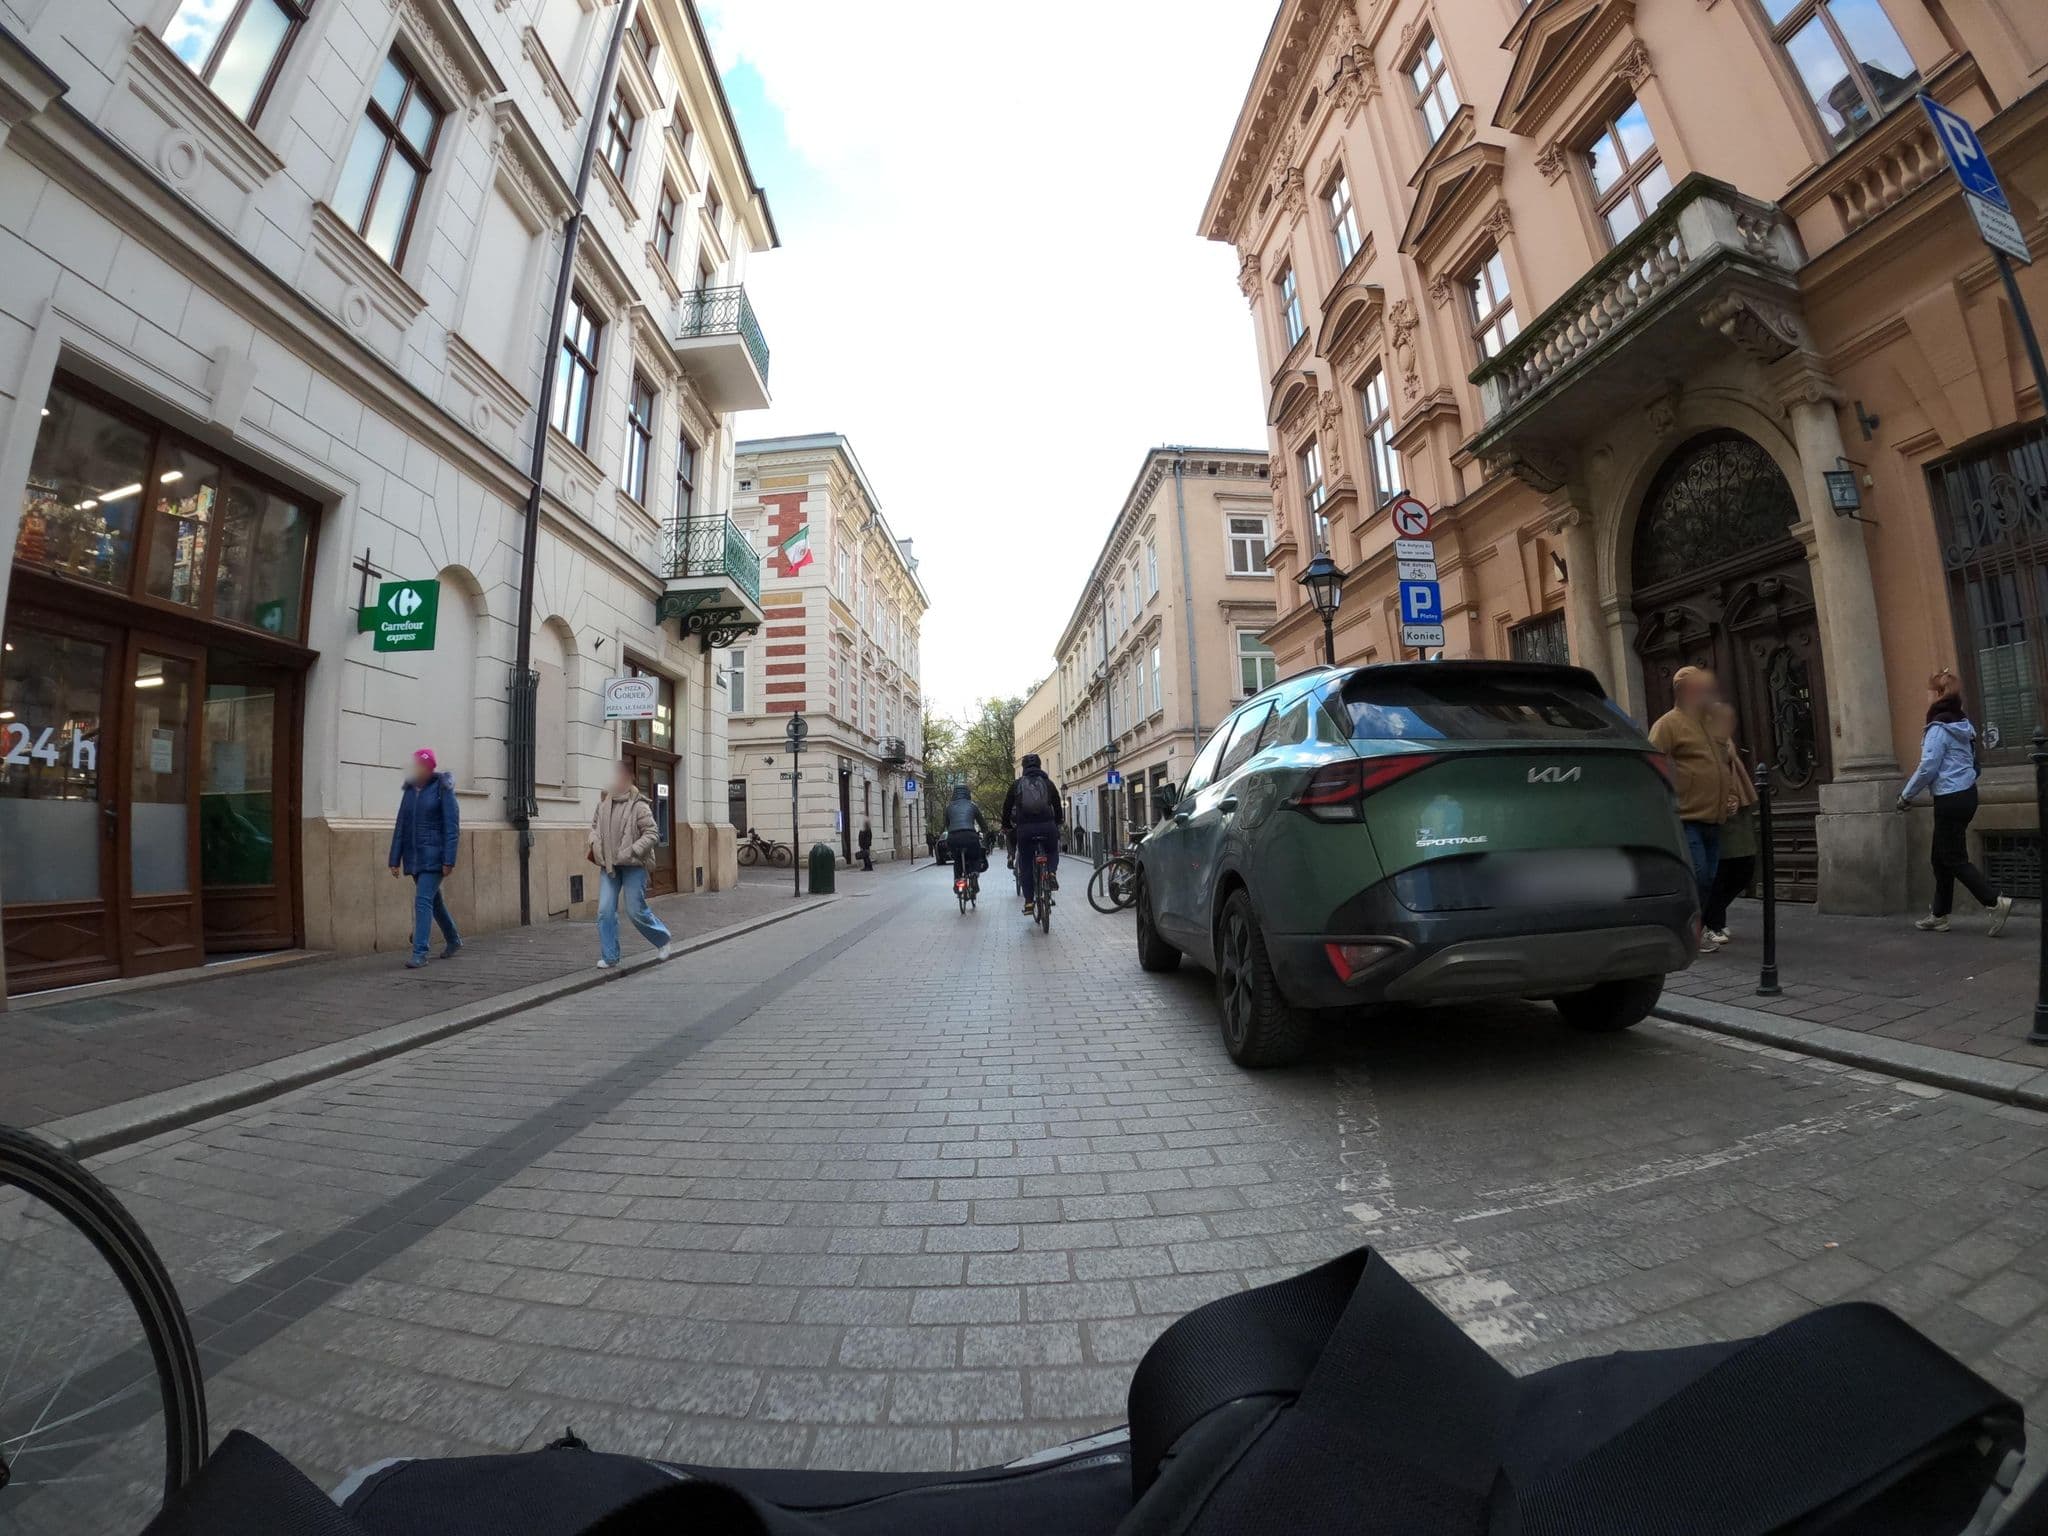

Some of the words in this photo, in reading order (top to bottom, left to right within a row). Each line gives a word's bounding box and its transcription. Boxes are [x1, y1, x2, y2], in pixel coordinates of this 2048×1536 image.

[1935, 108, 1978, 168] P
[1408, 586, 1432, 619] P
[381, 620, 424, 632] Carrefour
[386, 633, 416, 645] express
[1406, 631, 1441, 641] Koniec
[7, 722, 60, 767] 24
[72, 728, 96, 770] h
[1527, 766, 1582, 783] KIA
[907, 781, 915, 790] P
[1415, 835, 1489, 848] SPORTAGE
